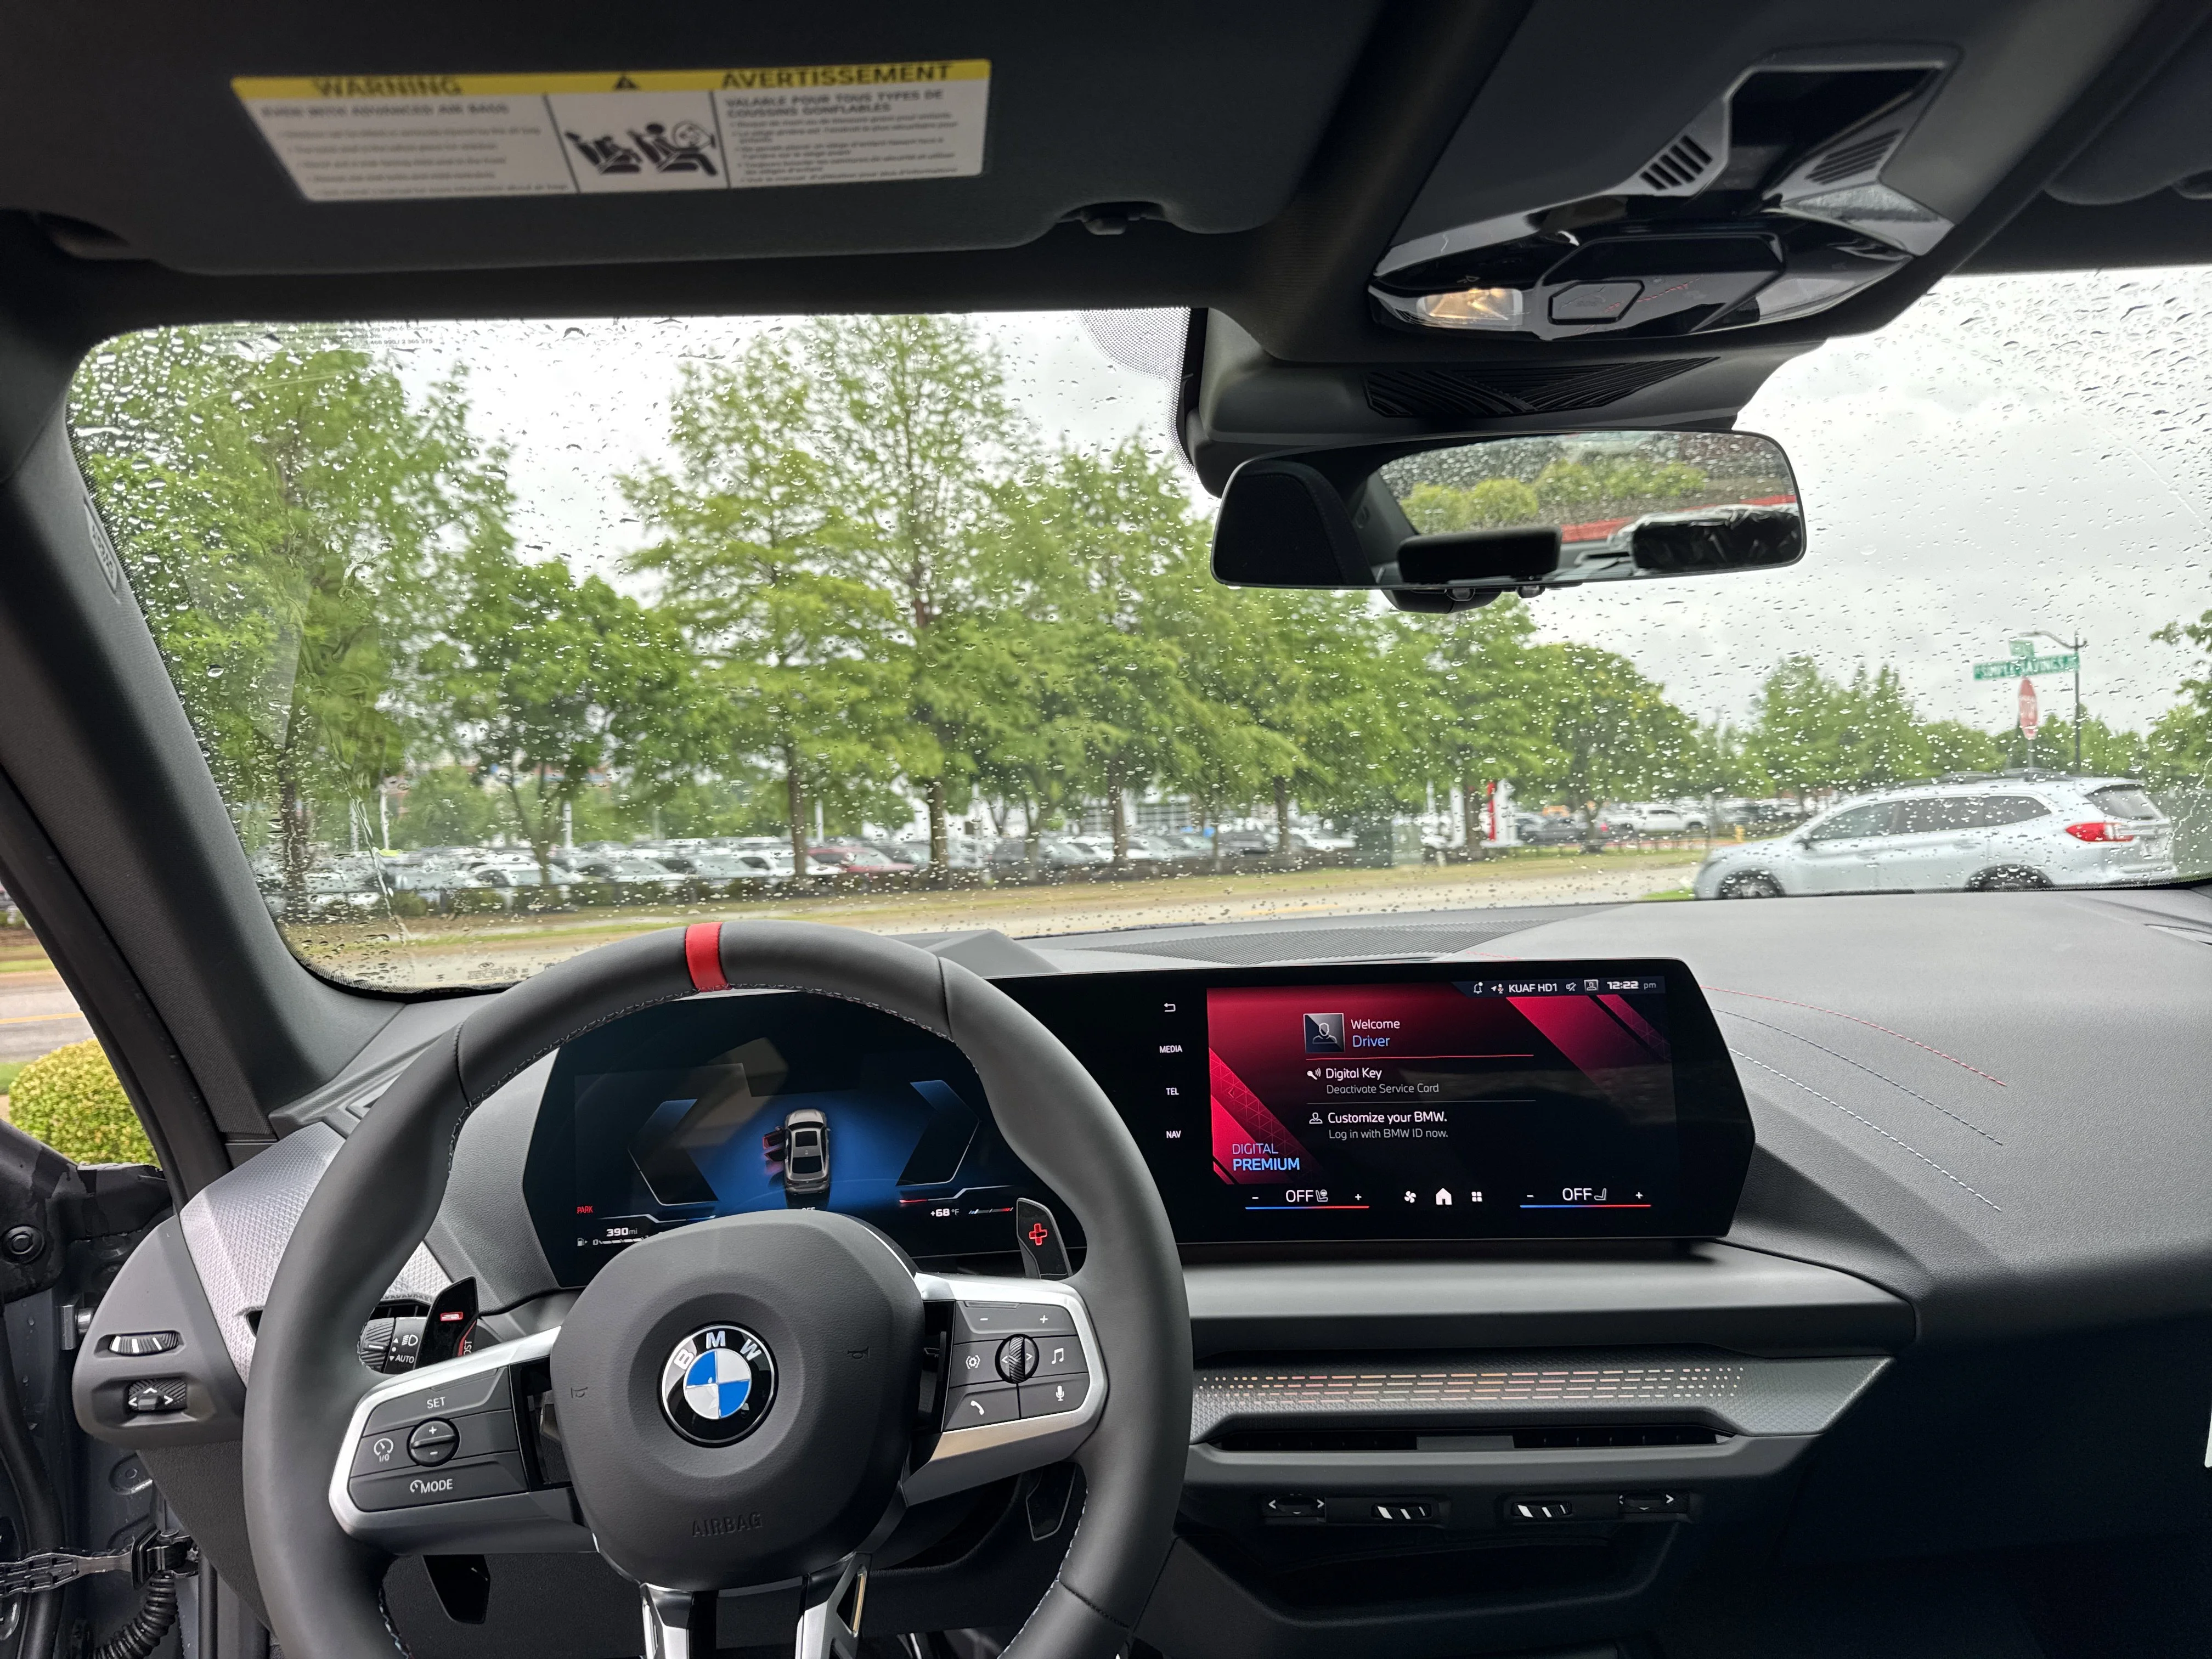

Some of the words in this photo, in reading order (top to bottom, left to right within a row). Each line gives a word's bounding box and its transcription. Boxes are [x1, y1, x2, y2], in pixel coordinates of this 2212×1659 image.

[721, 62, 953, 89] AVERTISSEMENT
[314, 76, 462, 97] WARNING
[1508, 984, 1536, 993] KUAF
[1537, 983, 1558, 992] HD1
[1606, 980, 1639, 990] 12:22
[1350, 1019, 1401, 1030] Welcome
[1352, 1035, 1390, 1047] Driver
[1159, 1045, 1183, 1053] MEDIA
[1325, 1068, 1359, 1081] Digital
[1362, 1067, 1383, 1080] Key
[1327, 1084, 1376, 1094] Deactivate
[1379, 1084, 1414, 1093] Service
[1417, 1083, 1440, 1093] Card
[1328, 1112, 1385, 1124] Customize
[1387, 1114, 1412, 1125] your
[1414, 1111, 1447, 1122] BMW.
[1166, 1130, 1182, 1138] NAV
[1329, 1129, 1347, 1141] Log
[1350, 1129, 1358, 1138] in
[1361, 1128, 1381, 1138] with
[1383, 1128, 1410, 1138] BMW
[1412, 1128, 1423, 1138] ID
[1232, 1143, 1279, 1155] DIGITAL
[1233, 1157, 1300, 1171] PREMIUM
[1285, 1189, 1314, 1203] OFF
[1562, 1188, 1593, 1201] OFF
[577, 1206, 594, 1214] PARK
[930, 1208, 950, 1217] +68
[673, 1330, 763, 1370] BMW
[395, 1354, 415, 1364] AUTO
[426, 1397, 446, 1409] SET
[420, 1479, 453, 1493] MODE
[692, 1512, 763, 1538] AIRBAG
